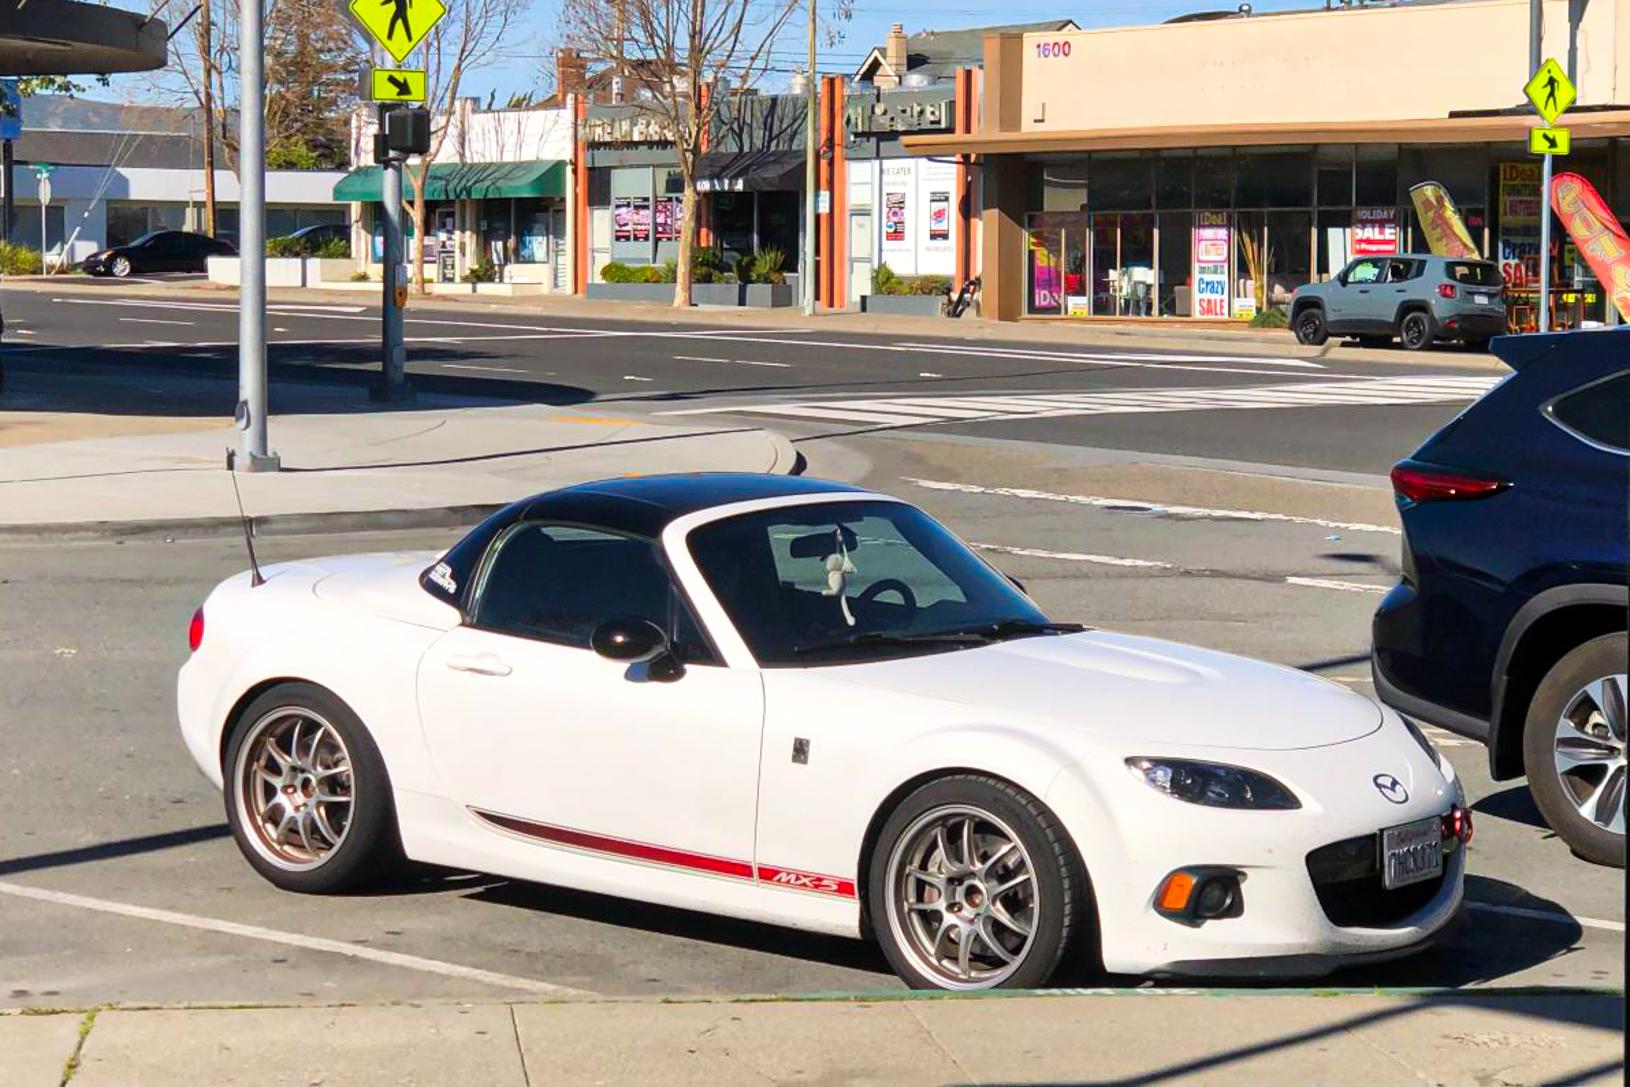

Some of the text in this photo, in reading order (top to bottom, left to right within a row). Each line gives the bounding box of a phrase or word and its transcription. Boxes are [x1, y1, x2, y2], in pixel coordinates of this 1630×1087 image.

[1036, 40, 1071, 58] 1600
[891, 167, 912, 175] CATER
[1199, 212, 1227, 225] iDeal
[1354, 223, 1396, 240] SALE
[1198, 277, 1226, 296] Crazy
[1198, 298, 1225, 316] SALE
[772, 871, 838, 891] MX-5
